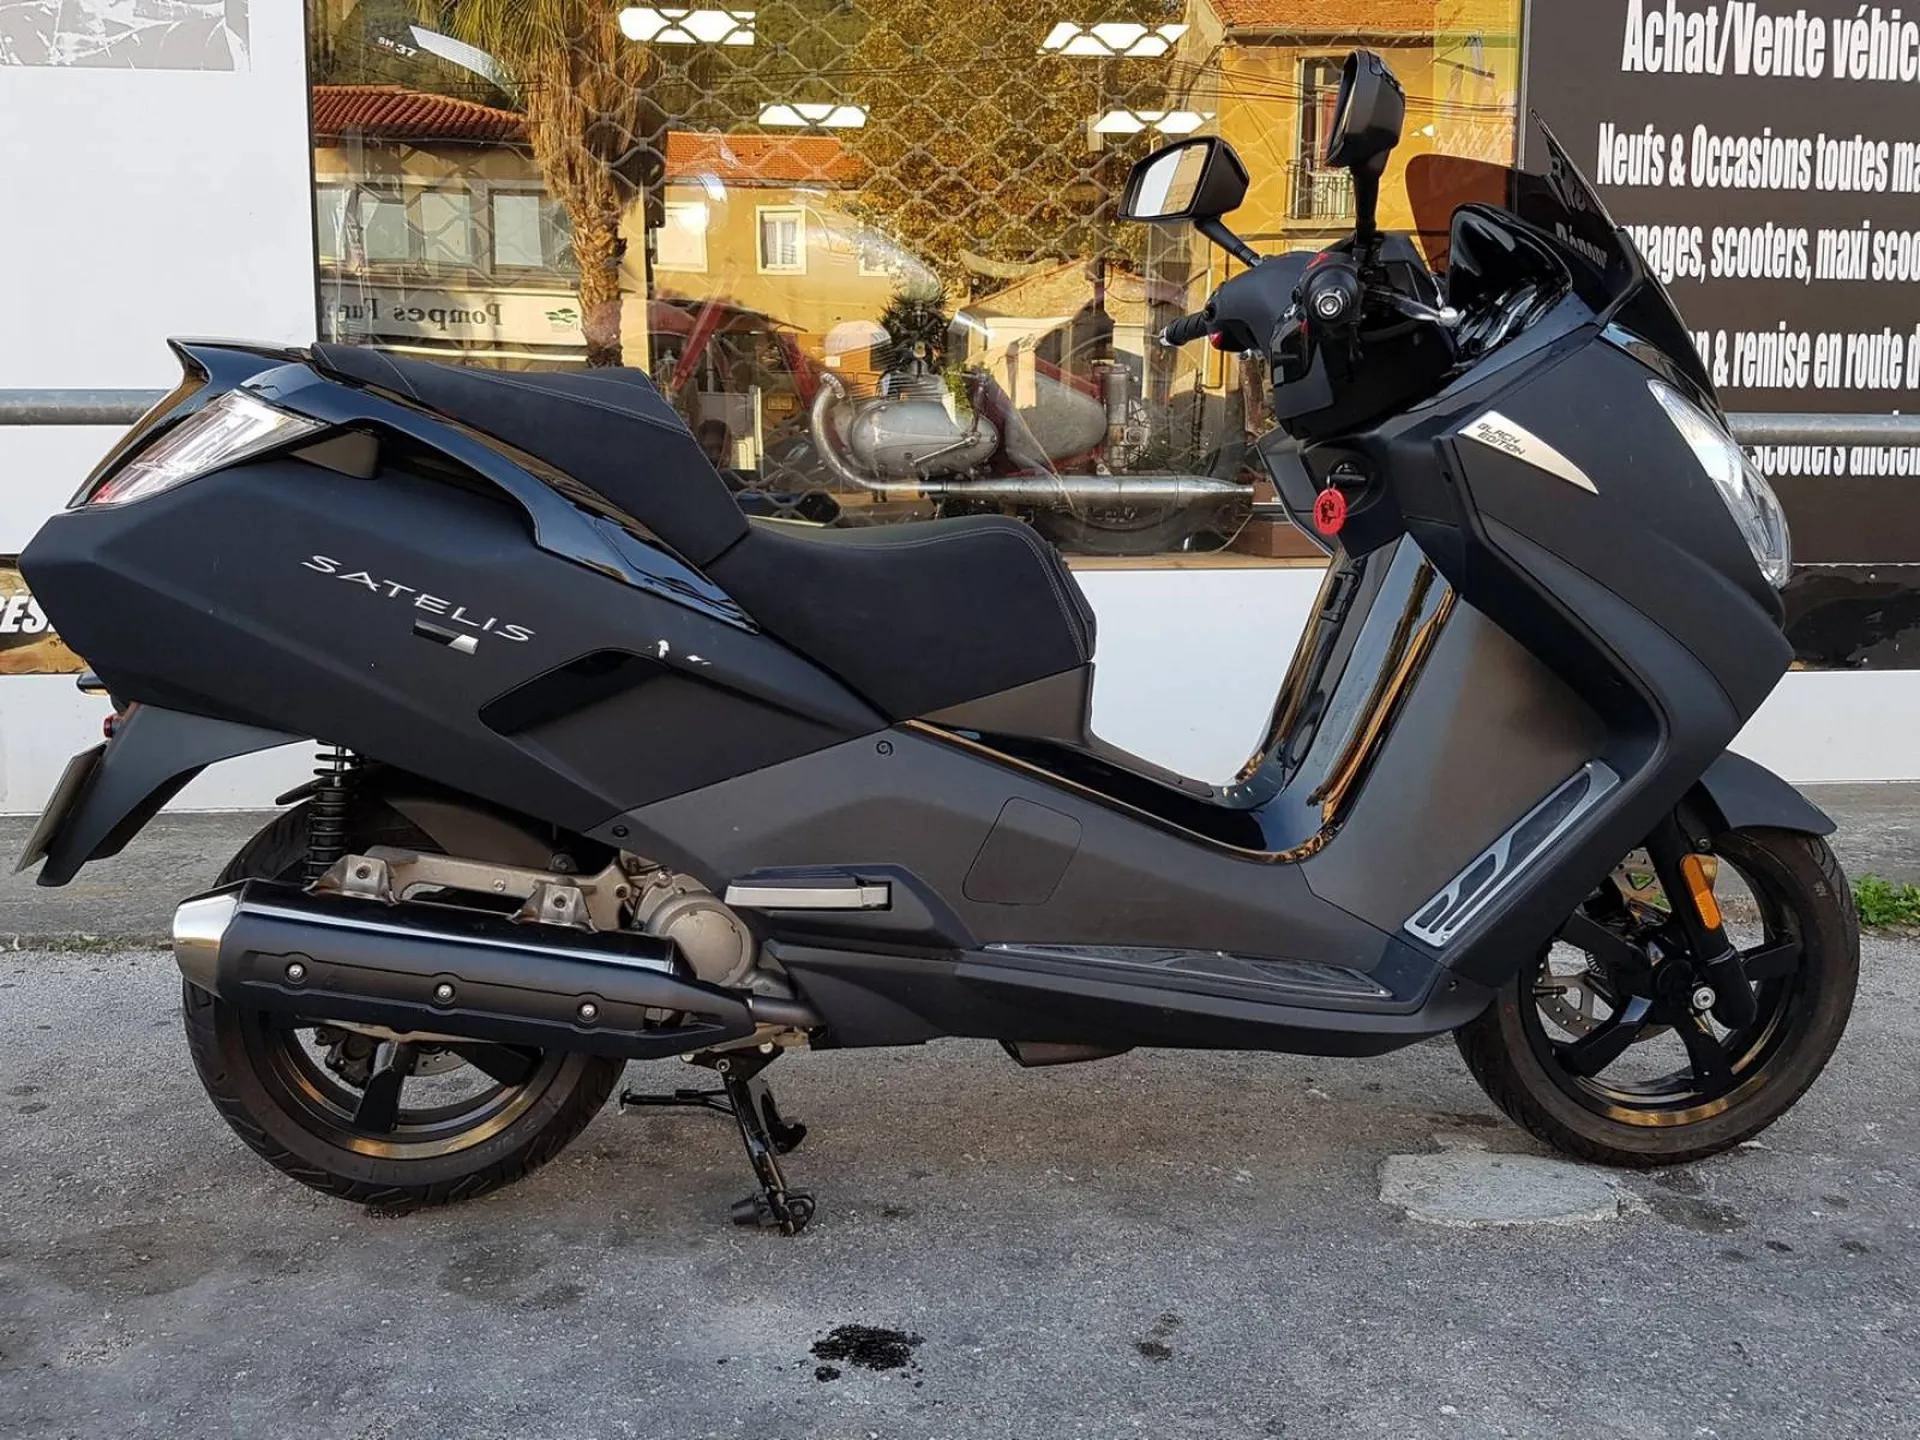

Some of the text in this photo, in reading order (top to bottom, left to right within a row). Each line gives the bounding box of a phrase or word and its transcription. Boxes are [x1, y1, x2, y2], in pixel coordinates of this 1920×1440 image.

[1621, 0, 1920, 82] Achat/Vente véhic
[1597, 122, 1665, 186] Neufs
[1668, 133, 1686, 187] &
[1691, 124, 1812, 190] Occasions
[1815, 133, 1889, 192] toutes
[1710, 221, 1811, 285] scooters,
[1815, 219, 1870, 280] maxi
[1713, 329, 1729, 388] &
[1732, 321, 1811, 389] remise
[1814, 332, 1842, 389] en
[1844, 327, 1903, 389] route
[1478, 432, 1526, 455] EDITION
[300, 555, 536, 642] SATELIS
